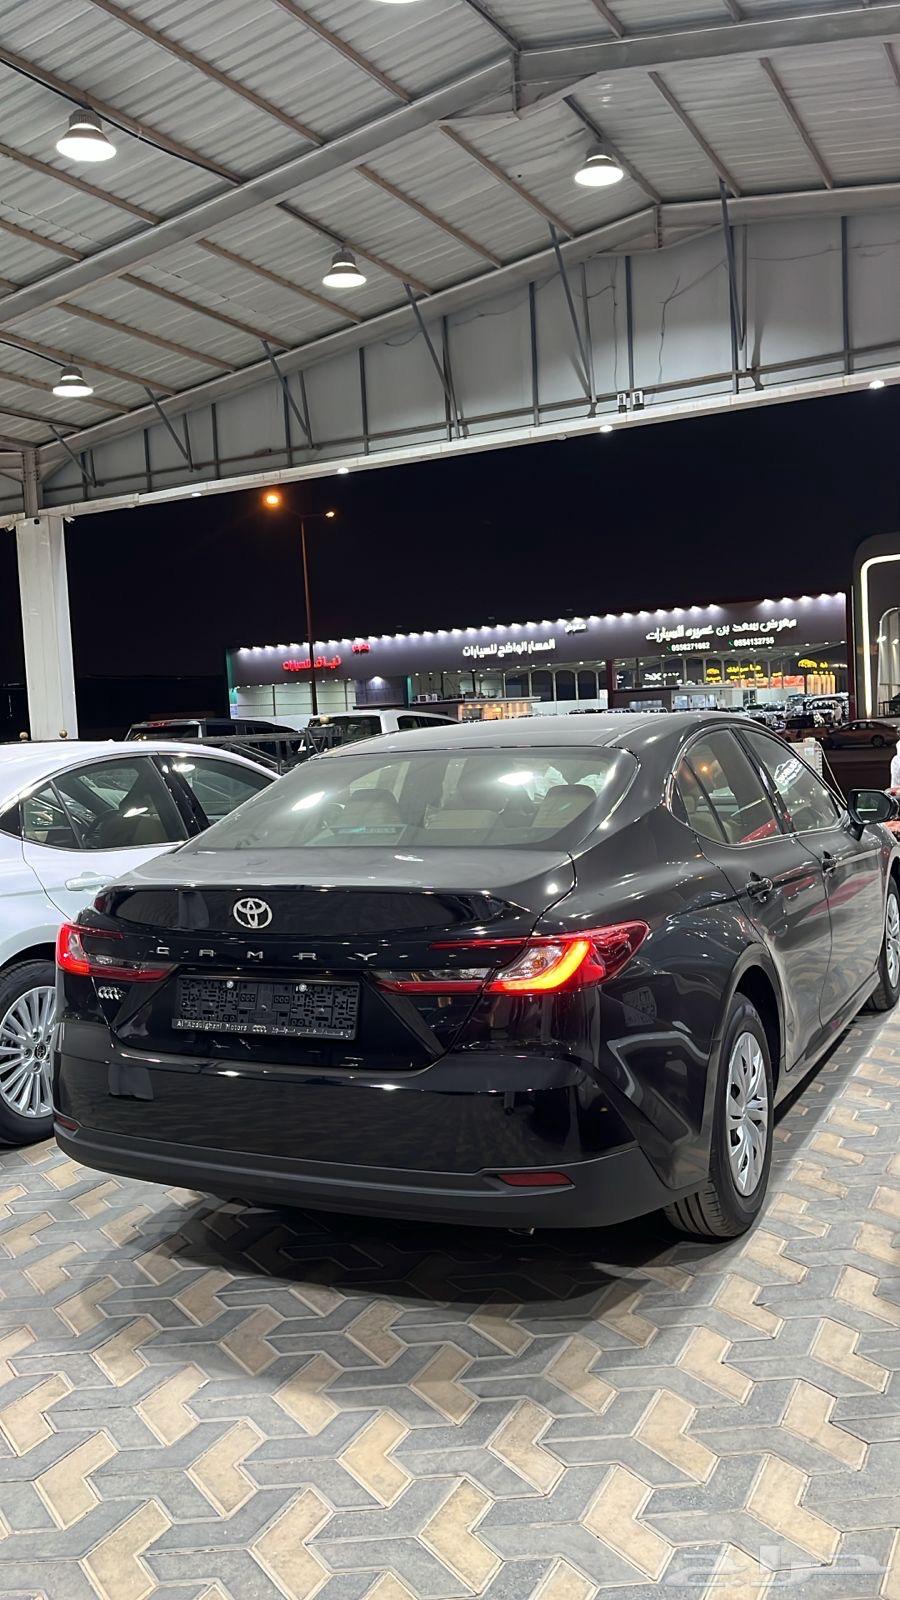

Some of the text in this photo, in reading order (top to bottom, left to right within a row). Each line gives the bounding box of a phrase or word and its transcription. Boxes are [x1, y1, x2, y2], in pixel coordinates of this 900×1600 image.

[716, 625, 730, 636] بن
[732, 622, 759, 632] سعد
[760, 618, 797, 632] معرض
[462, 638, 556, 659] المسار الواضح للسيارات
[156, 946, 378, 962] CAMRY
